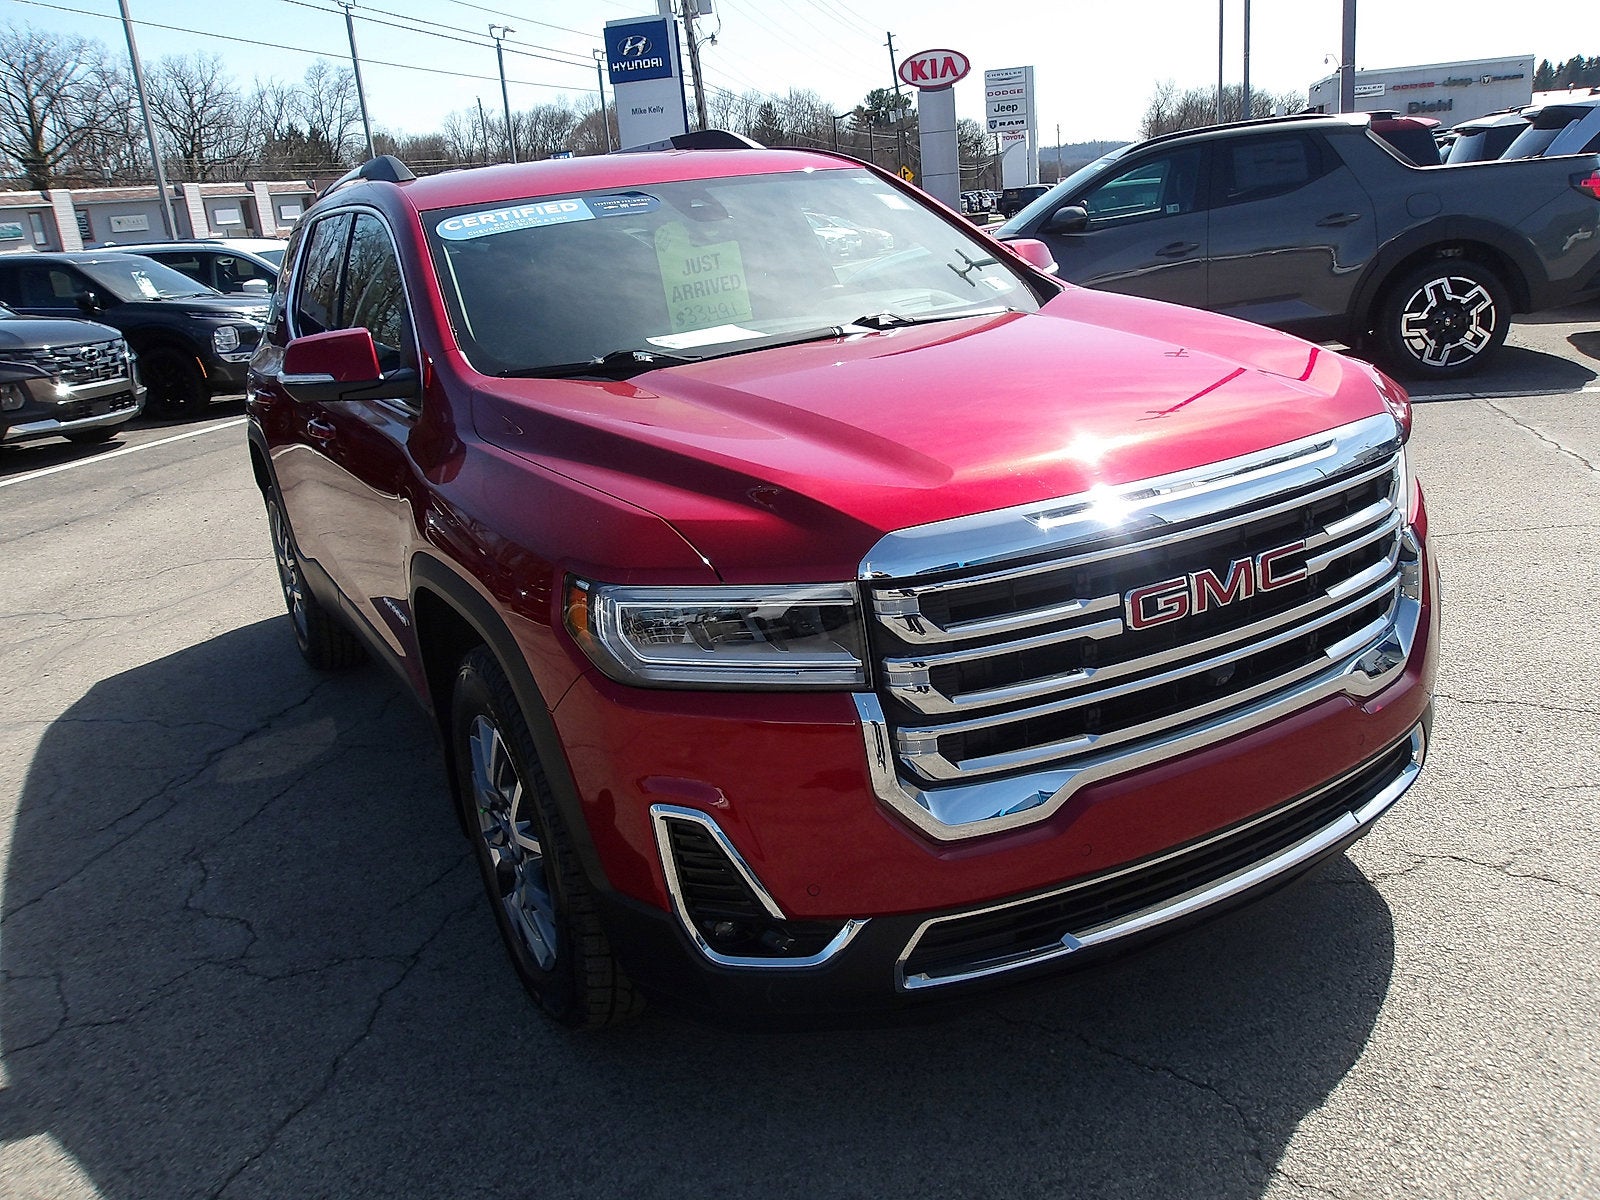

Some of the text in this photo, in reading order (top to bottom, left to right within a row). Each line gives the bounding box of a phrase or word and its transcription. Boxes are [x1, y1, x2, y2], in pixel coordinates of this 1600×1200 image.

[612, 57, 663, 72] HYUNDAI
[910, 56, 959, 81] KIA
[986, 70, 1022, 78] CHRYSLER
[986, 88, 1024, 97] DODGE
[631, 105, 664, 116] Mike Kelly
[993, 102, 1019, 113] Jeep
[998, 119, 1025, 127] RAM
[443, 202, 579, 231] CERTIFIED
[682, 253, 721, 276] JUST
[672, 273, 741, 303] ARRIVED
[1125, 539, 1308, 631] GMC
